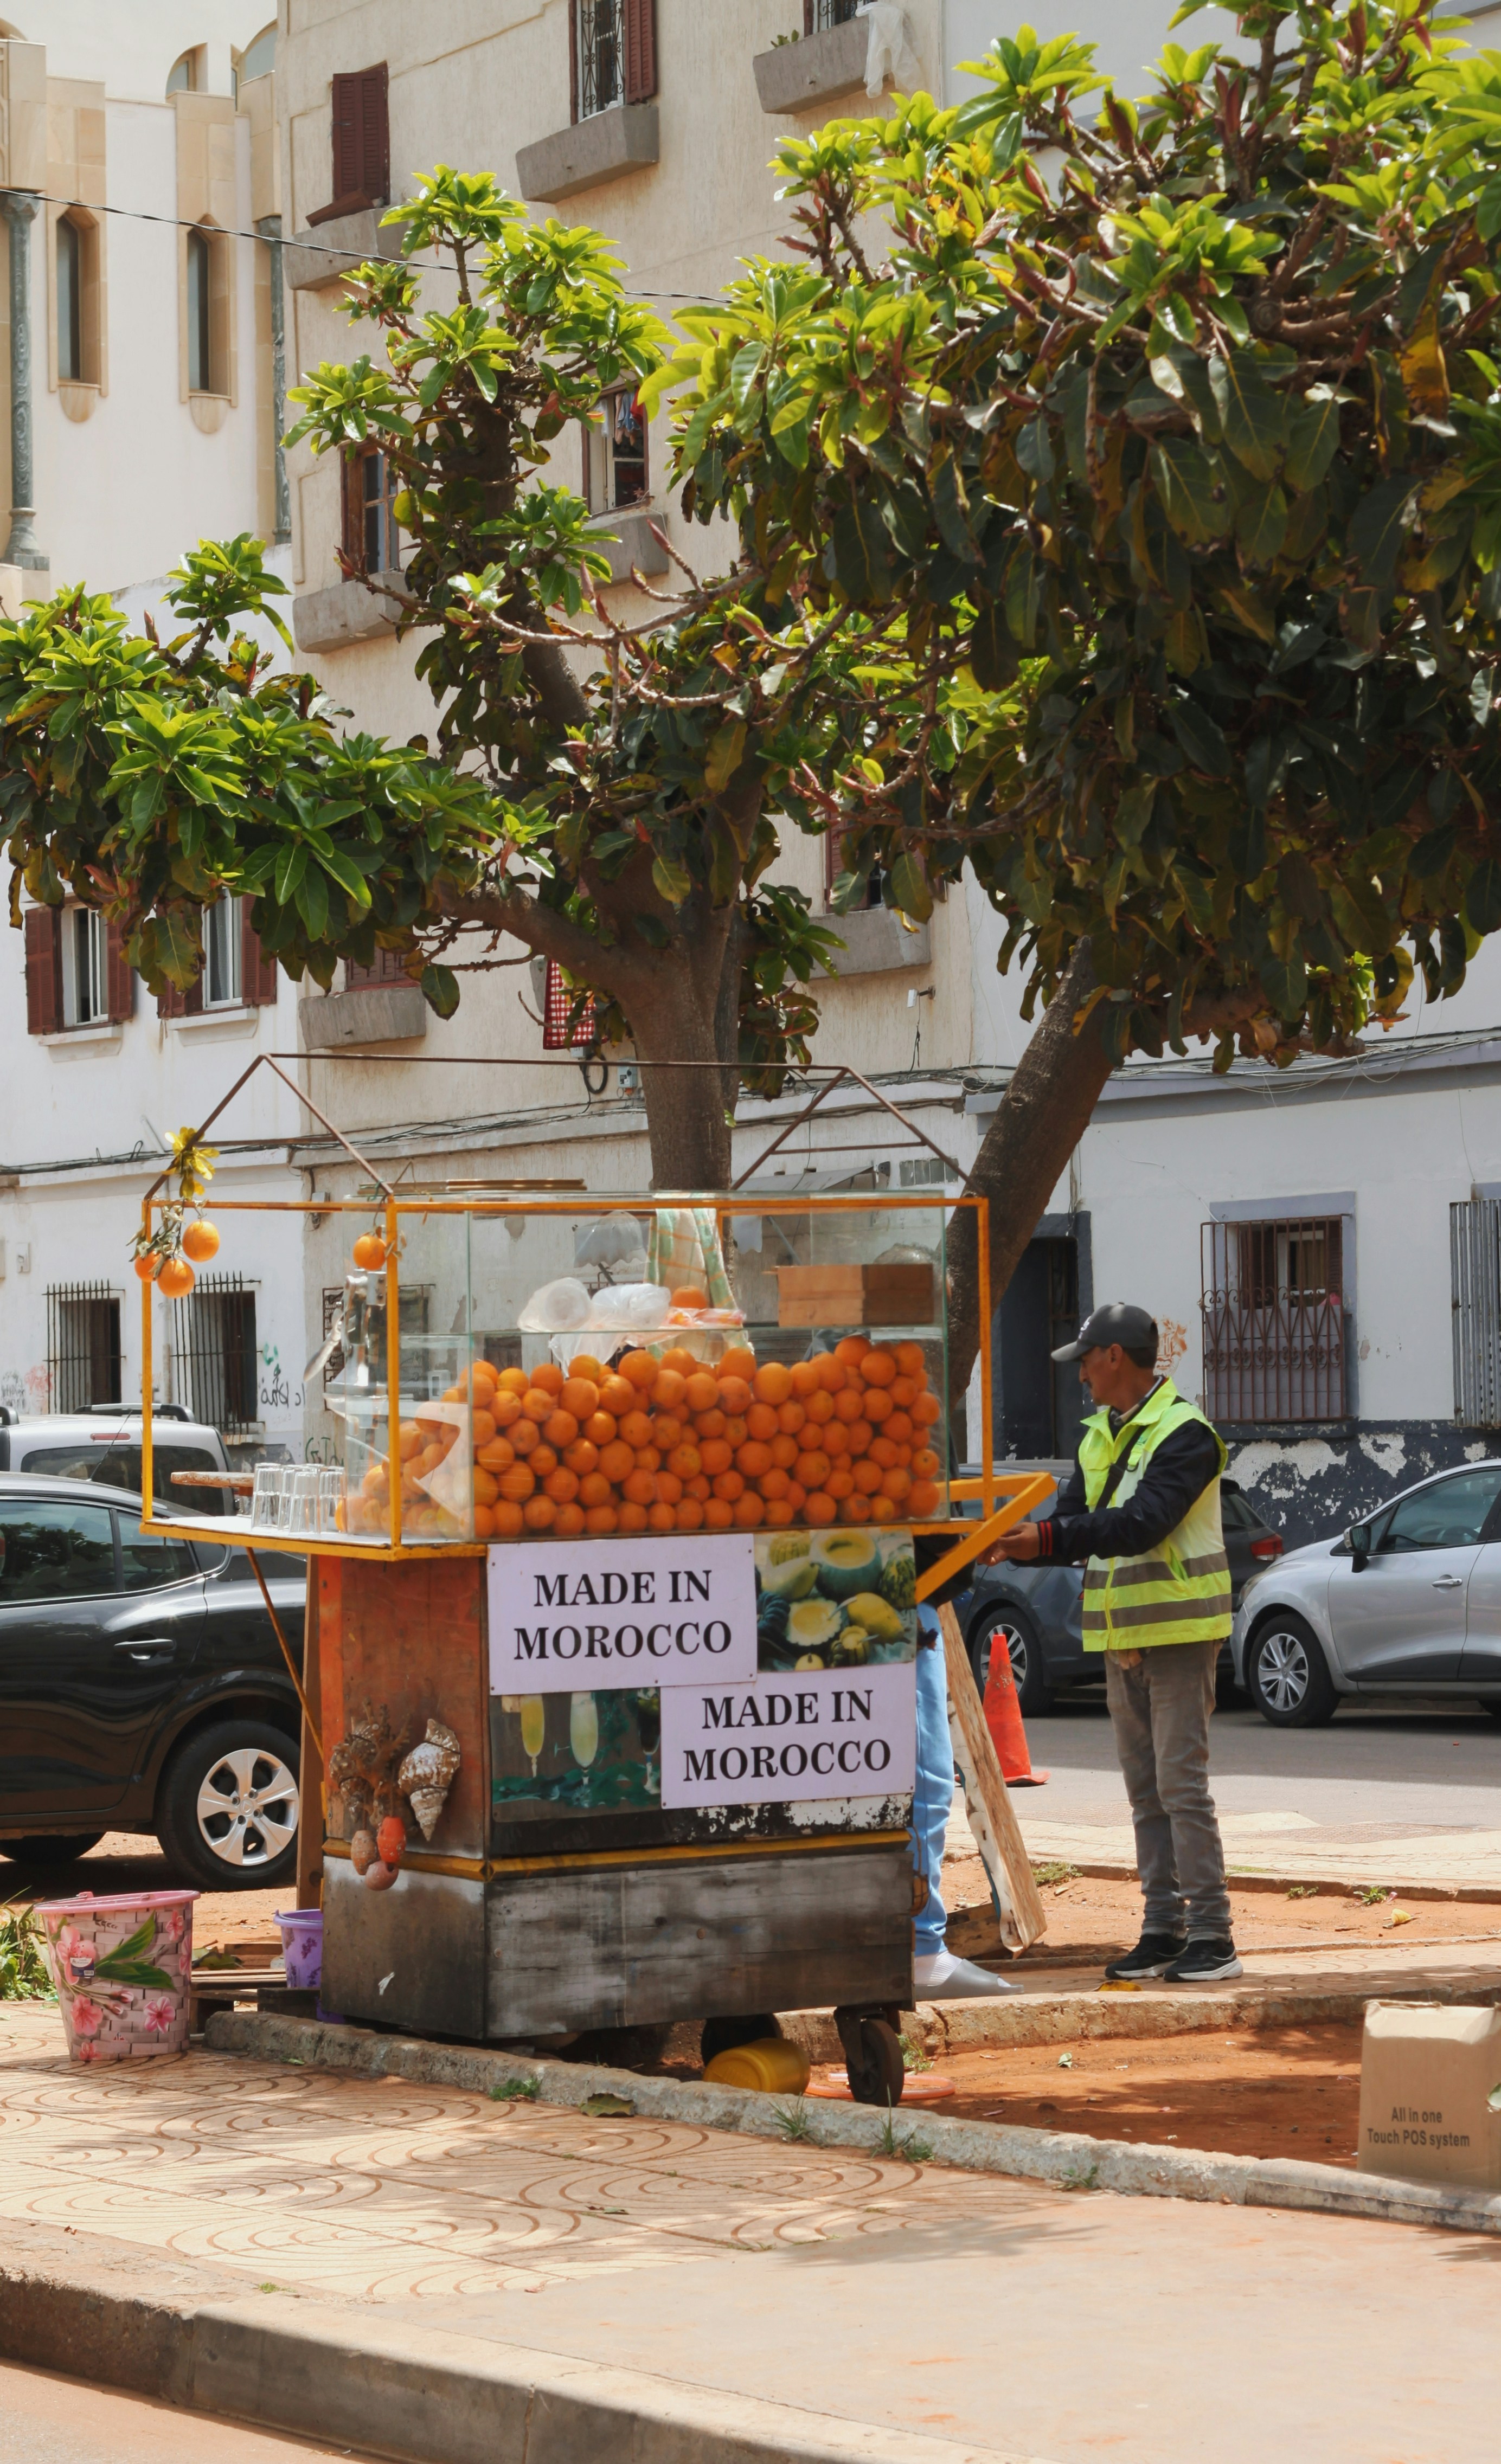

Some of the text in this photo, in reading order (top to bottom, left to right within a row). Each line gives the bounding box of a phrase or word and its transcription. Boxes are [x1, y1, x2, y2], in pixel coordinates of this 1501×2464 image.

[534, 1569, 713, 1607] MADE IN
[513, 1620, 732, 1661] MOROCCO
[701, 1689, 874, 1730] MADE IN
[682, 1738, 891, 1783] MOROCCO
[1391, 2107, 1442, 2124] All in one
[1367, 2128, 1470, 2150] Touch POS system
